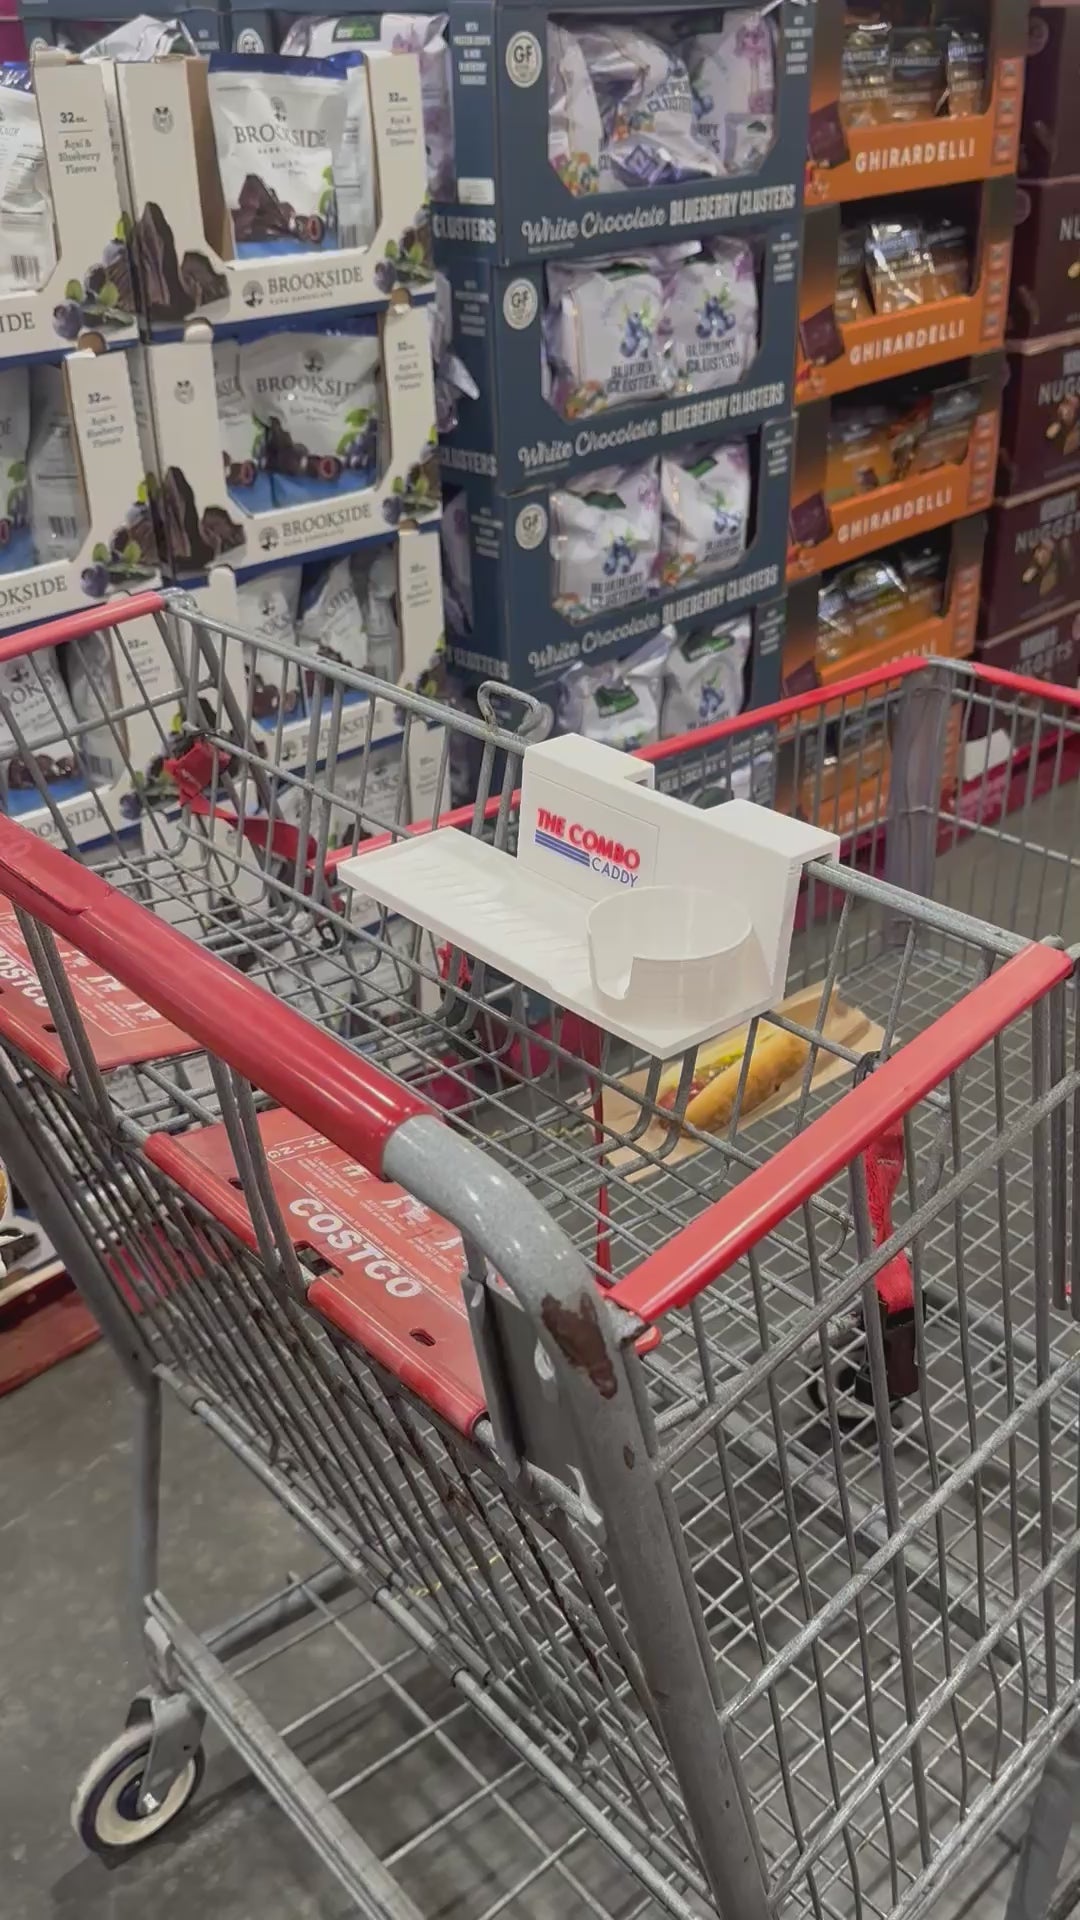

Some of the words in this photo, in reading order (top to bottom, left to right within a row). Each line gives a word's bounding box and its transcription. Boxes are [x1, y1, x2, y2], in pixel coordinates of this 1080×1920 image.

[514, 44, 532, 64] GF
[60, 111, 75, 123] 32
[855, 137, 976, 173] GHIRARDELLI
[432, 214, 497, 244] CLUSTERS
[521, 216, 580, 244] White
[580, 205, 667, 239] Chocolate
[669, 193, 739, 226] BLUEBERRY
[739, 183, 796, 216] CLUSTERS
[267, 266, 363, 296] BROOKSIDE
[850, 319, 965, 366] GHIRARDELLI
[518, 441, 574, 468] White
[575, 419, 659, 457] Chocolate
[661, 396, 730, 435] BLUEBERRY
[729, 383, 786, 417] CLUSTERS
[282, 504, 372, 537] BROOKSIDE
[837, 488, 952, 544] GHIRARDELLI
[528, 638, 579, 670] White
[581, 613, 660, 653] Chocolate
[662, 586, 725, 625] BLUEBERRY
[726, 563, 780, 602] CLUSTERS
[537, 807, 566, 838] THE
[568, 823, 641, 870] COMBO
[591, 857, 638, 887] CADDY
[289, 1198, 423, 1298] COSTCO
